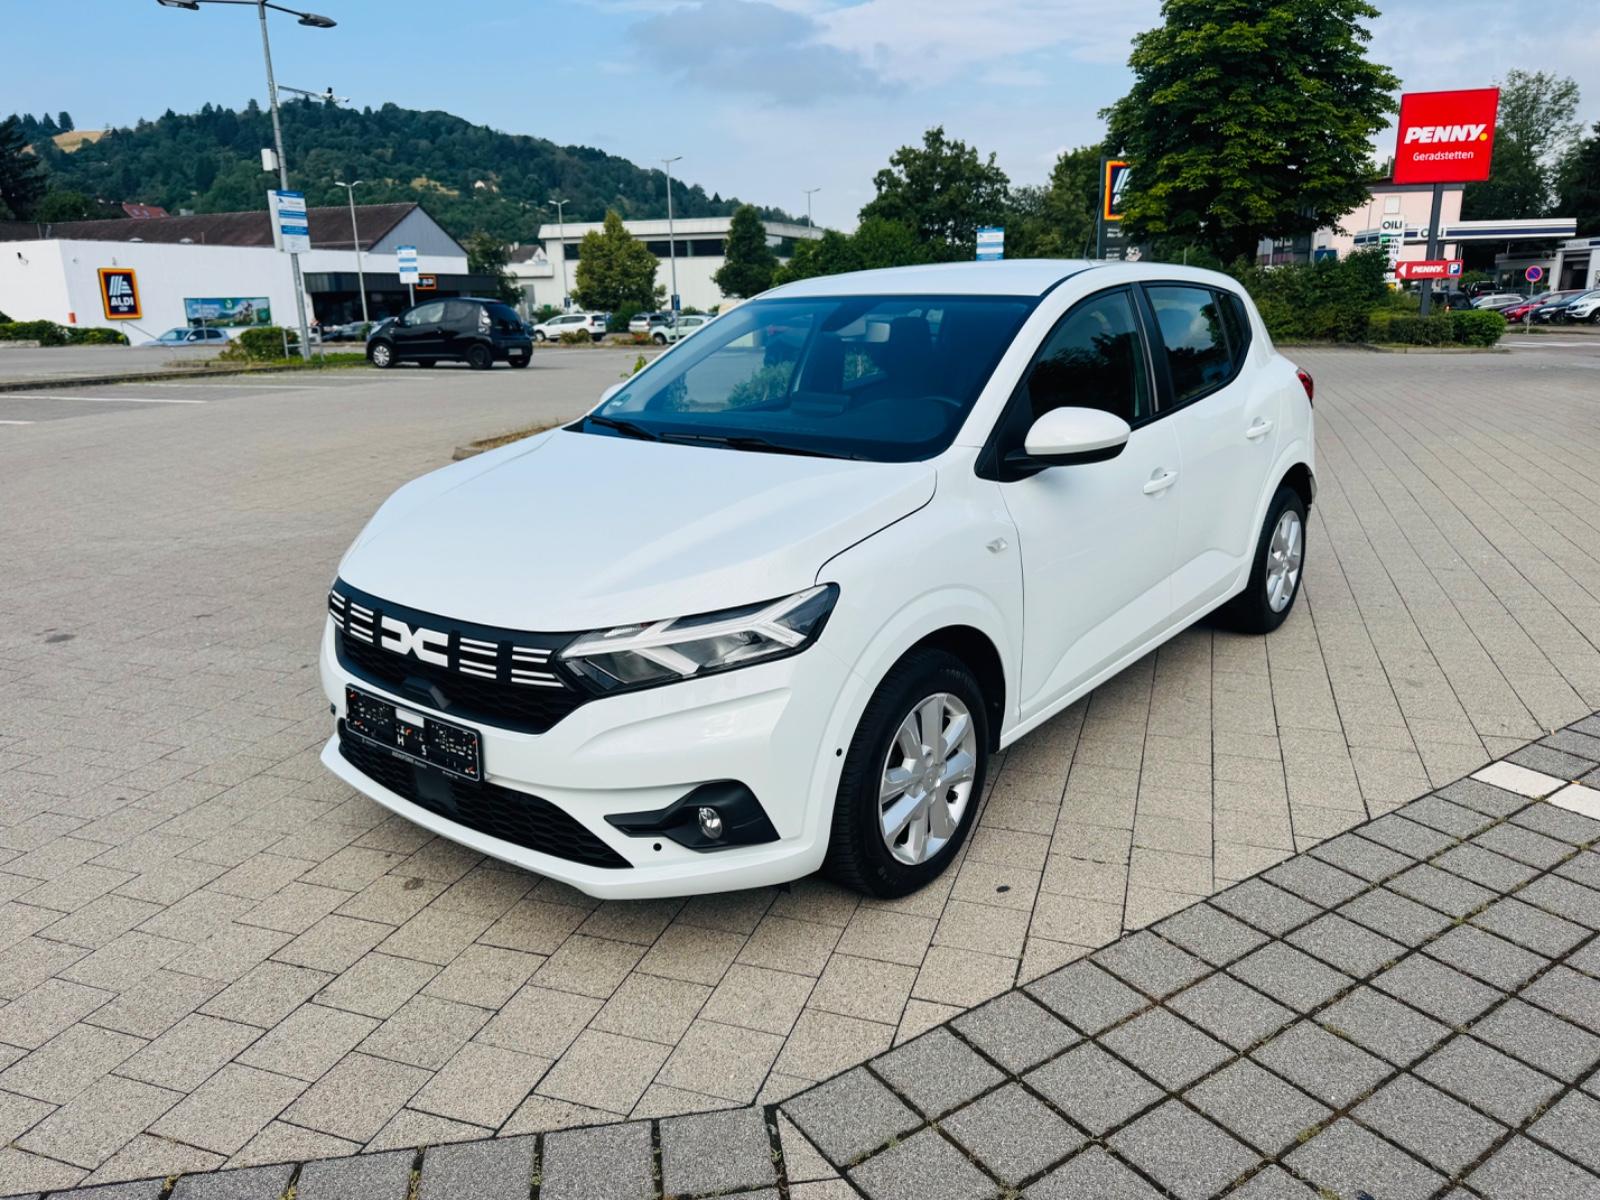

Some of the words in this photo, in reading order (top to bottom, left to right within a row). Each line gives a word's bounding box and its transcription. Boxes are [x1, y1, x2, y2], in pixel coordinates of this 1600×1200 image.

[1412, 151, 1474, 161] Geradstetten
[1382, 220, 1403, 230] OILI
[110, 296, 134, 307] ALDI
